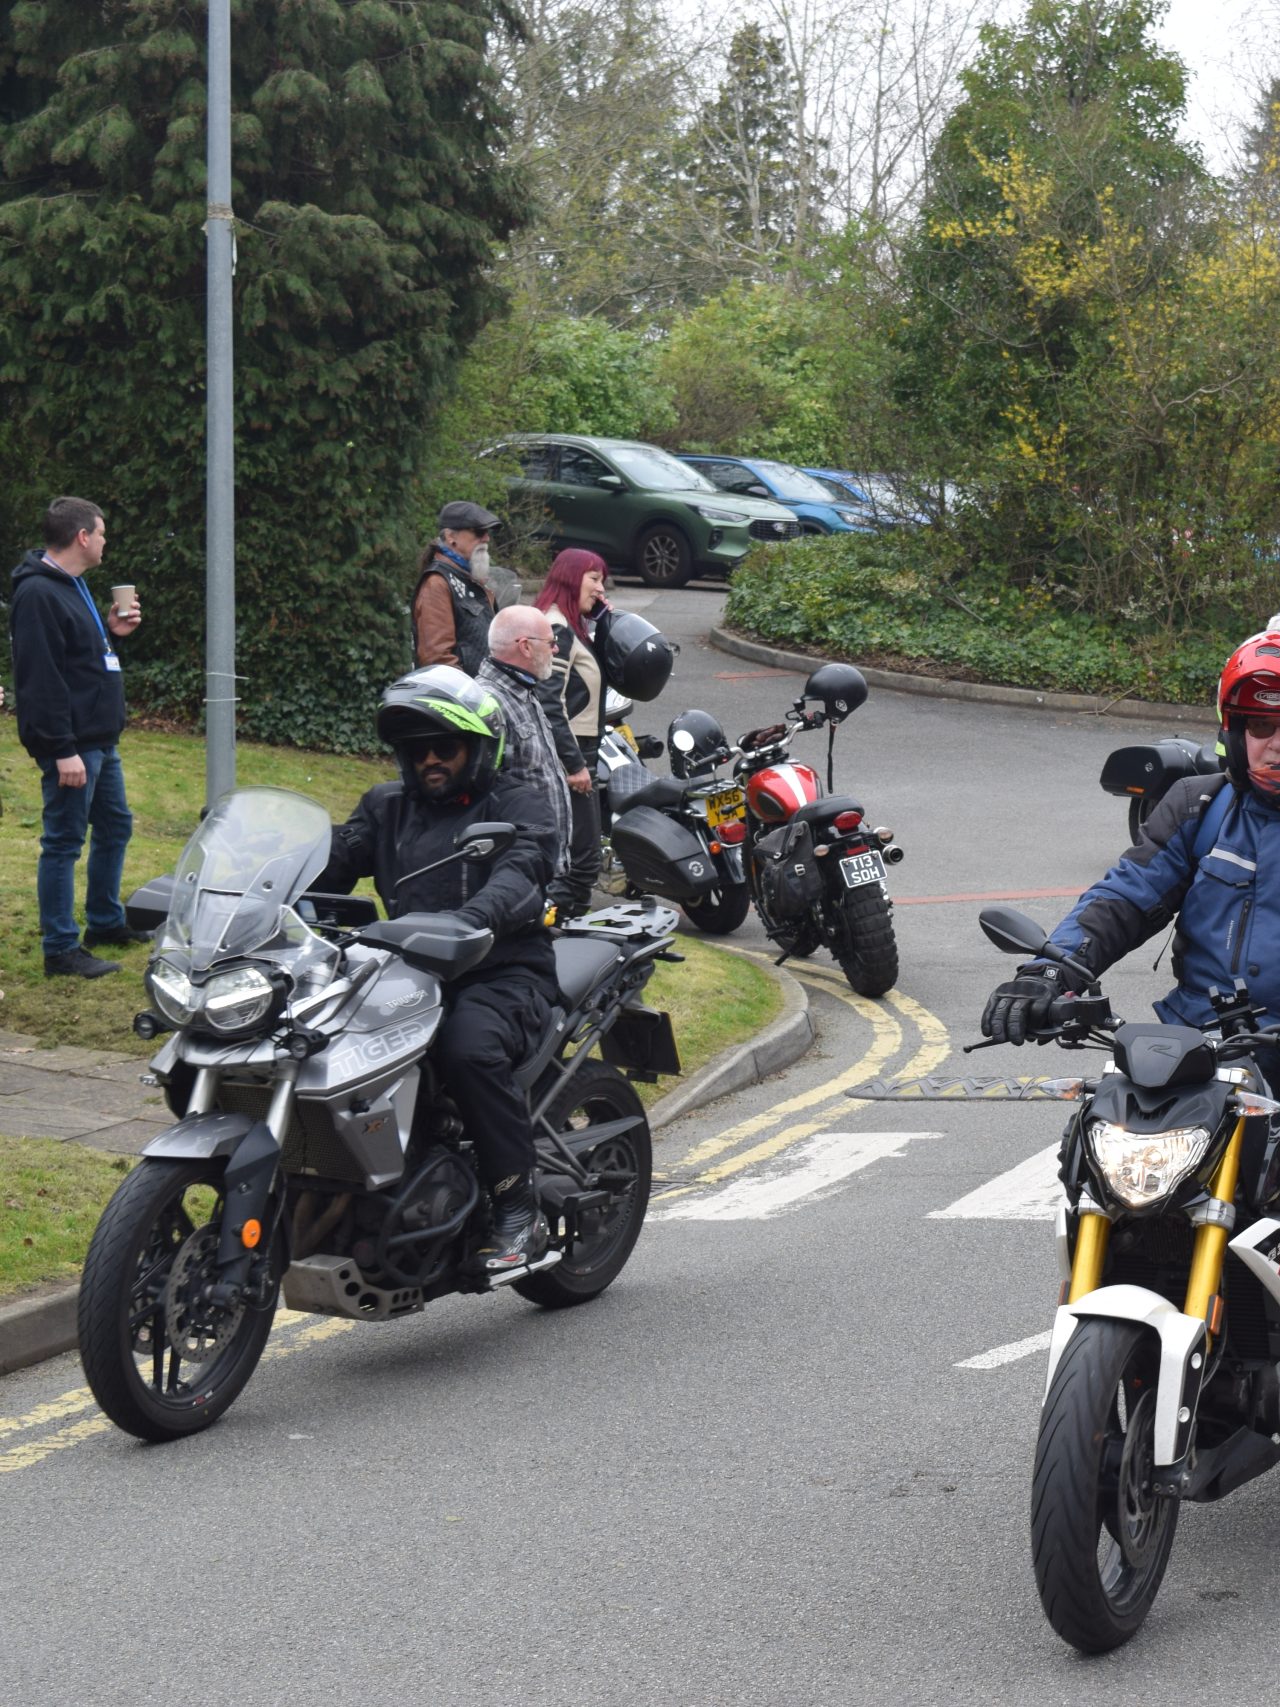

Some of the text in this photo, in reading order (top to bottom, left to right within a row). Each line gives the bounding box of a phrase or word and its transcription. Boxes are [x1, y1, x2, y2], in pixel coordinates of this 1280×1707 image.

[708, 789, 740, 810] WX56
[385, 988, 429, 1010] TRIUMPH
[328, 1021, 430, 1078] TIGER
